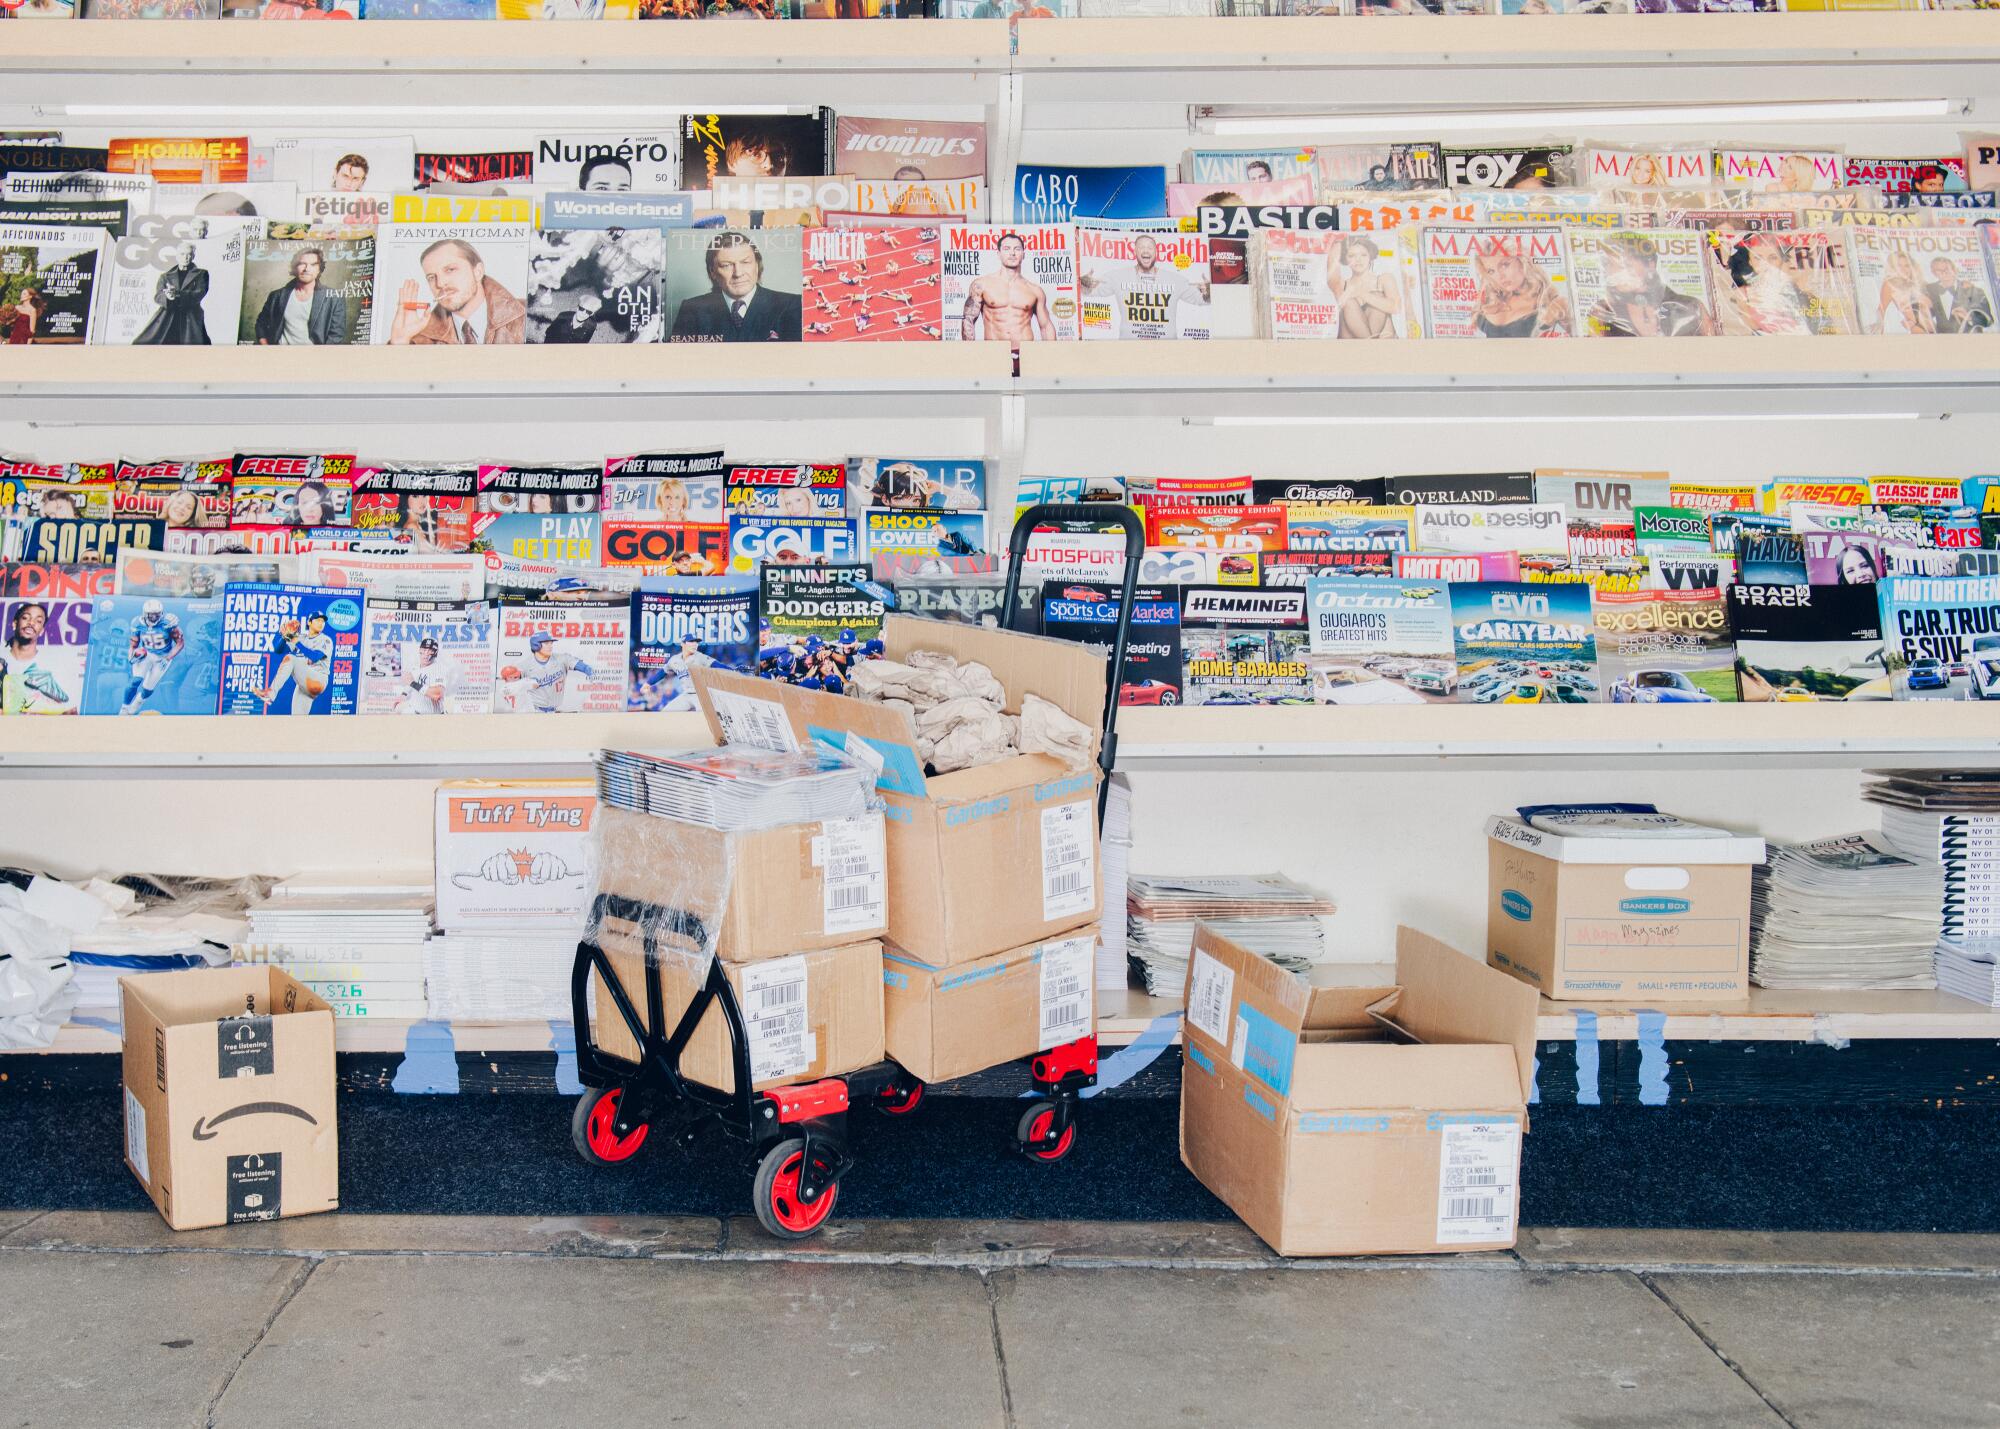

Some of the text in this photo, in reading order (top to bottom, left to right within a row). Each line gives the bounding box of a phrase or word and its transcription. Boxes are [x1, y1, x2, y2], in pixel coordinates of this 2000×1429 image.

[539, 137, 667, 163] Numéro
[844, 133, 978, 156] HOMMES
[655, 173, 668, 182] 50
[1446, 154, 1525, 188] FOX
[1846, 165, 1937, 180] CASTING
[305, 197, 389, 219] l'étique
[554, 200, 683, 216] Wonderland
[1200, 207, 1332, 235] BASIC
[672, 234, 796, 250] THE RAKE
[1431, 233, 1559, 257] MAXIM
[1855, 235, 1979, 251] PENTHOUSE
[944, 251, 979, 263] WINTER
[944, 264, 979, 276] MUSCLE
[1033, 257, 1072, 273] GORKA
[344, 281, 373, 290] JASON
[1040, 273, 1072, 285] MARQUEZ
[1433, 277, 1475, 289] JESSICA
[326, 289, 372, 298] BATEMAN
[1125, 292, 1172, 307] JELLY
[1084, 302, 1111, 311] OLYMPIC
[1084, 310, 1111, 319] MUSCLE!
[1128, 308, 1169, 322] ROLL
[238, 458, 352, 473] FREE XXX
[495, 472, 598, 488] FREE VIDEOS MODELS
[728, 468, 840, 485] FREE XXX
[1286, 485, 1354, 500] Classic
[1400, 489, 1495, 505] OVERLAND
[1574, 481, 1632, 510] OVR
[1876, 485, 1958, 499] CLASSIC CAR
[1672, 493, 1734, 508] TRUCK
[1158, 506, 1281, 515] SPECIAL COLLECTORS' EDITION
[870, 516, 939, 529] SHOOT
[1423, 511, 1561, 529] Auto&Design
[311, 530, 340, 538] WORLD
[542, 518, 592, 538] PLAY
[1569, 528, 1631, 538] Grassroots
[733, 527, 847, 560] GOLF
[1290, 537, 1405, 550] MASERATI
[1862, 524, 1982, 548] Classic Cars
[513, 539, 592, 560] BETTER
[608, 530, 721, 560] GOLF
[522, 565, 557, 573] AWARDS
[1066, 567, 1109, 576] McLaren's
[1403, 558, 1480, 582] HOT ROD
[1659, 560, 1719, 569] Performance
[1661, 568, 1718, 590] VW
[808, 586, 834, 594] Angeles
[836, 585, 856, 593] Times
[1736, 586, 1796, 597] ROAD
[226, 594, 302, 614] FANTASY
[642, 602, 750, 613] 2025 CHAMPIONS!
[767, 600, 885, 616] DODGERS
[1191, 598, 1299, 612] HEMMINGS
[1492, 594, 1549, 617] evo
[1736, 596, 1812, 607] TRACK
[774, 617, 878, 627] Champions Again!
[1320, 613, 1386, 628] GIUGIARO'S
[1596, 602, 1725, 630] excellence
[371, 624, 491, 642] FANTASY
[505, 622, 624, 638] BASEBALL
[641, 611, 750, 645] DODGERS
[1321, 630, 1387, 641] GREATEST HITS
[1459, 623, 1510, 641] CAR
[1520, 622, 1588, 641] YEAR
[223, 632, 275, 651] INDEX
[1489, 642, 1517, 650] GREATEST
[1519, 642, 1534, 650] CARS
[1618, 635, 1704, 647] ELECTRIC BOOST,
[1618, 645, 1707, 656] EXPLOSIVE SPEED!
[226, 665, 264, 678] ADVICE
[334, 661, 352, 672] 525
[1189, 661, 1307, 678] HOME GARAGES
[461, 802, 583, 828] Tuff Tying
[1622, 901, 1686, 909] BANKERS BOX
[1564, 981, 1623, 990] SmoothMove
[224, 1041, 267, 1051] free listening
[233, 1168, 276, 1179] free listening
